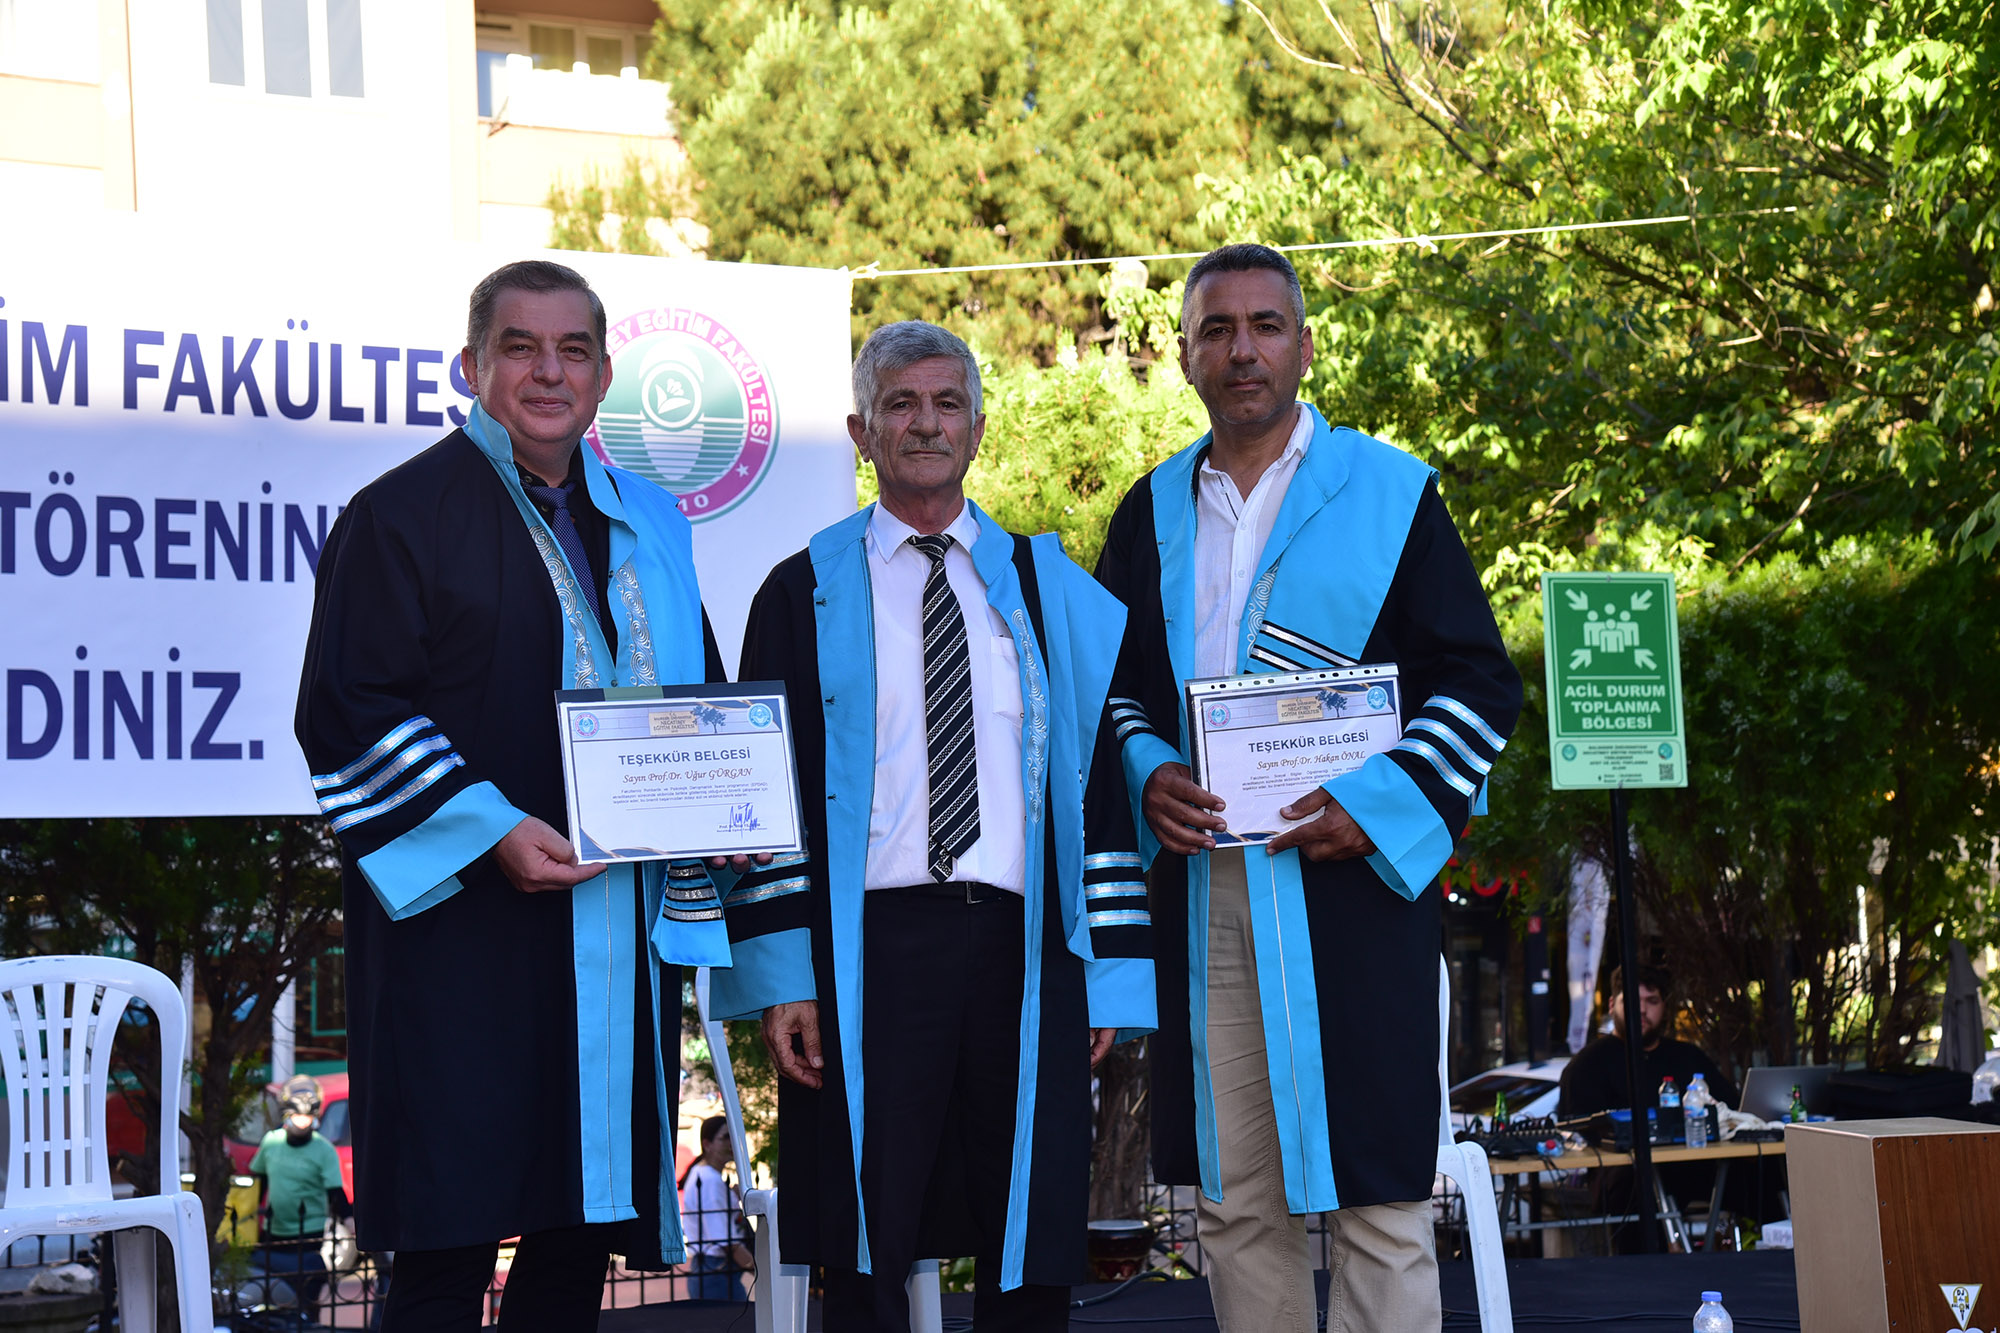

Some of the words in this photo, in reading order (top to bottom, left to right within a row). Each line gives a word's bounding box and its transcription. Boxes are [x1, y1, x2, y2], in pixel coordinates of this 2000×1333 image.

[1564, 682, 1603, 698] ACİL
[1606, 684, 1666, 697] DURUM
[1571, 701, 1661, 713] TOPLANMA
[1582, 714, 1653, 730] BÖLGESİ
[1248, 736, 1316, 753] TEŞEKKÜR
[1319, 729, 1369, 746] BELGESİ
[618, 750, 691, 767] TEŞEKKÜR
[694, 746, 751, 762] BELGESİ
[1257, 761, 1279, 771] Sayın
[1314, 753, 1340, 764] Hakan
[1341, 751, 1366, 760] ÖNAL
[623, 774, 647, 785] Sayın
[685, 770, 707, 781] Uğur
